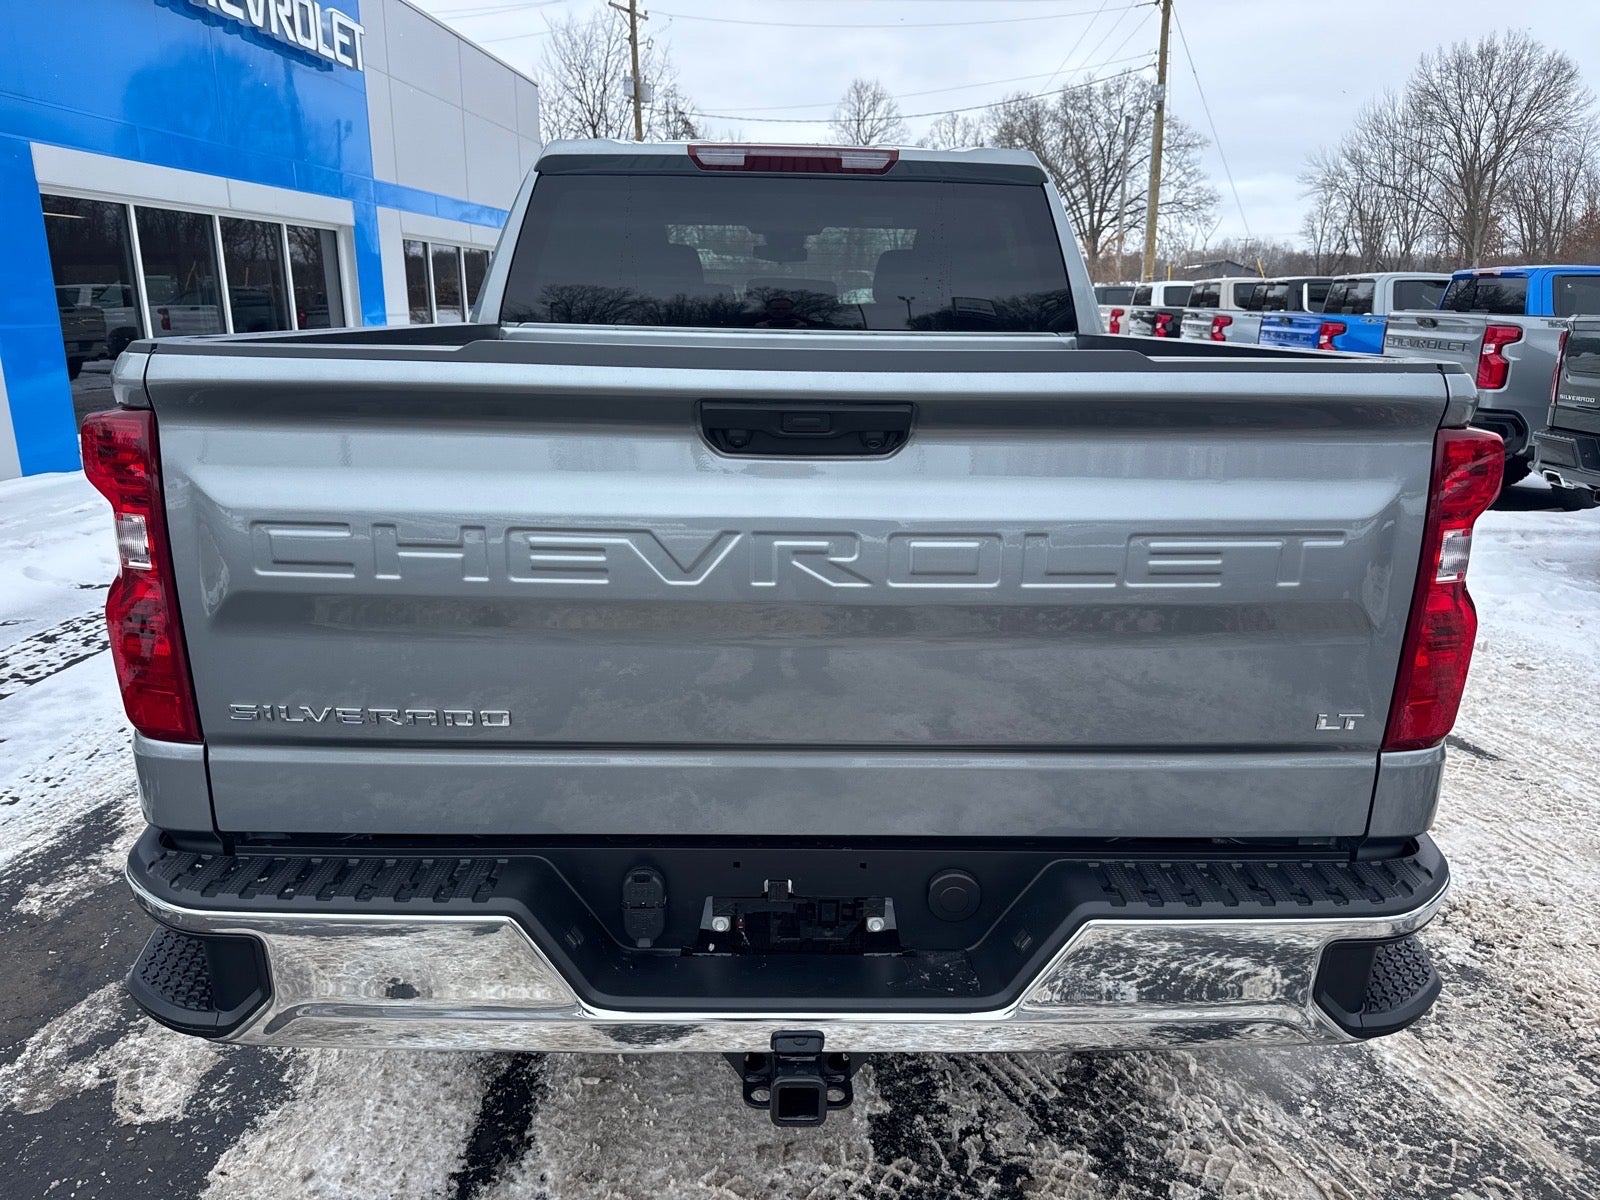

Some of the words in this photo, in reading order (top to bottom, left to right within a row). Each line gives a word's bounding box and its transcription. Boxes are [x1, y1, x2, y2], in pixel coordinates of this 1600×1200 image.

[250, 520, 1346, 589] CHEVROLET
[229, 703, 512, 728] SILVERADO
[1315, 712, 1365, 730] LT
